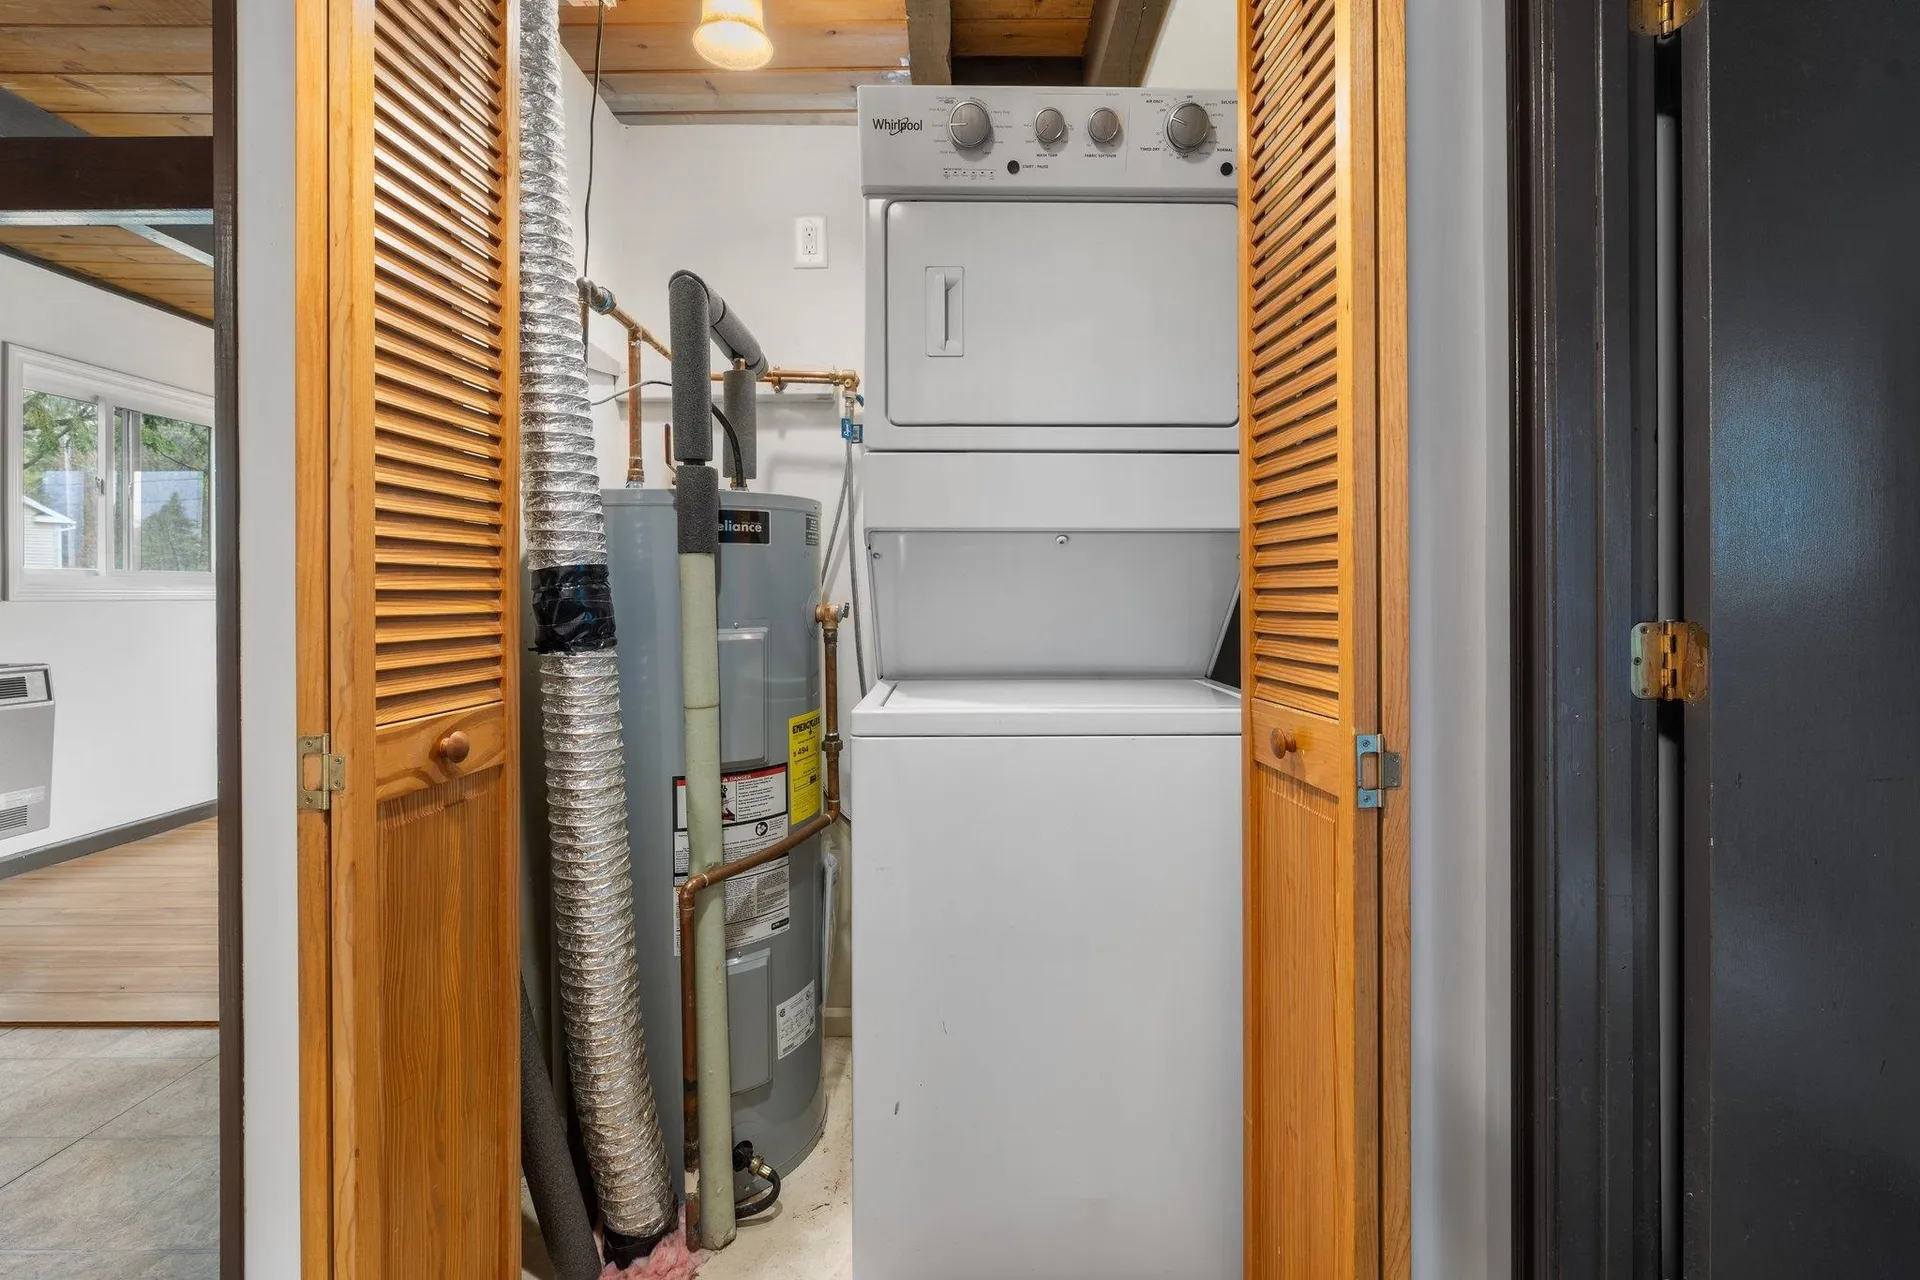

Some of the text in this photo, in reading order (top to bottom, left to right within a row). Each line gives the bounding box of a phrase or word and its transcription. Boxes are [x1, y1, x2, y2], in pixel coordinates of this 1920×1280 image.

[872, 117, 923, 136] Whirlpool
[718, 520, 762, 532] eliance
[729, 774, 752, 782] DANGER
